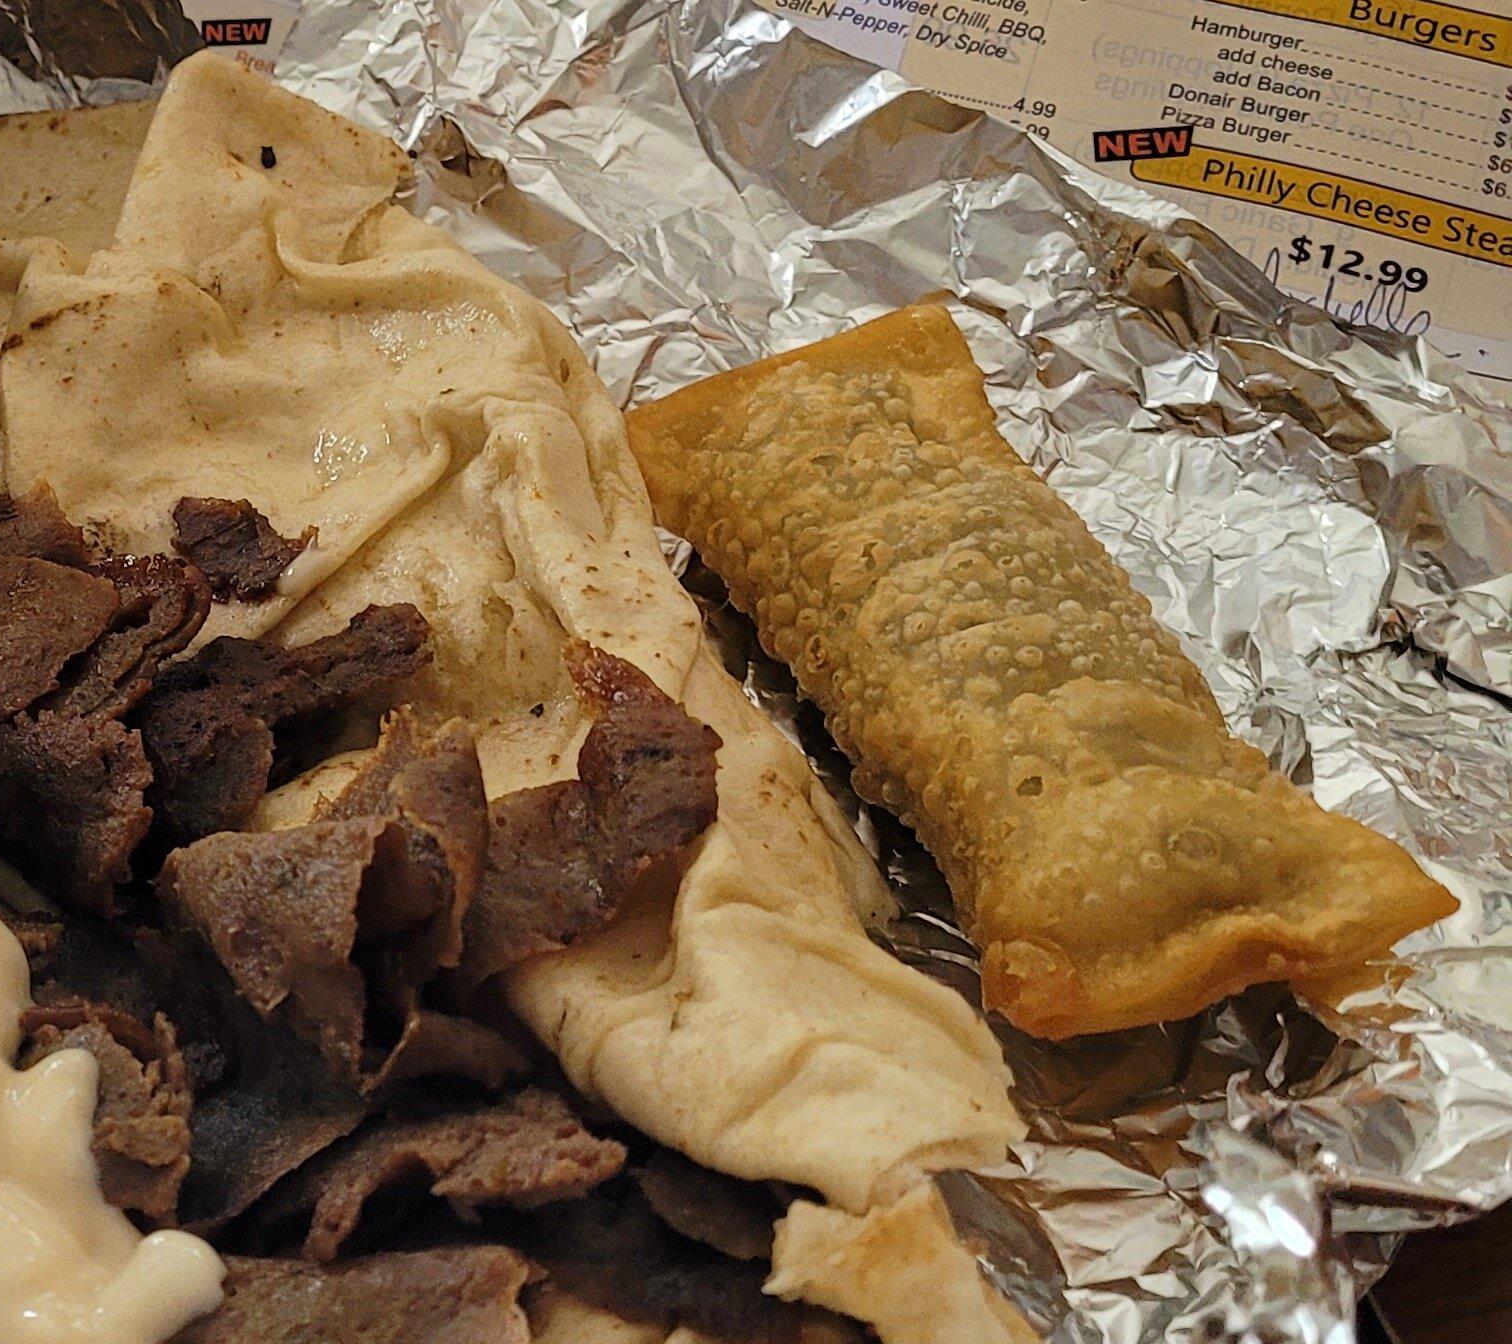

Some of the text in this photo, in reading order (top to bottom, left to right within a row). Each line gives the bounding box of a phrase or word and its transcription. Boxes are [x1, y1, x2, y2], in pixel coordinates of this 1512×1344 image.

[205, 22, 266, 42] NEW
[998, 18, 1048, 47] BBQ,
[1190, 15, 1304, 53] Hamburger
[1217, 45, 1334, 81] add cheese
[1168, 83, 1312, 126] Donair Burger
[1097, 130, 1188, 159] NEW
[1201, 158, 1297, 205] Philly
[1306, 180, 1432, 236] Cheese
[1288, 234, 1430, 294] $12.99
